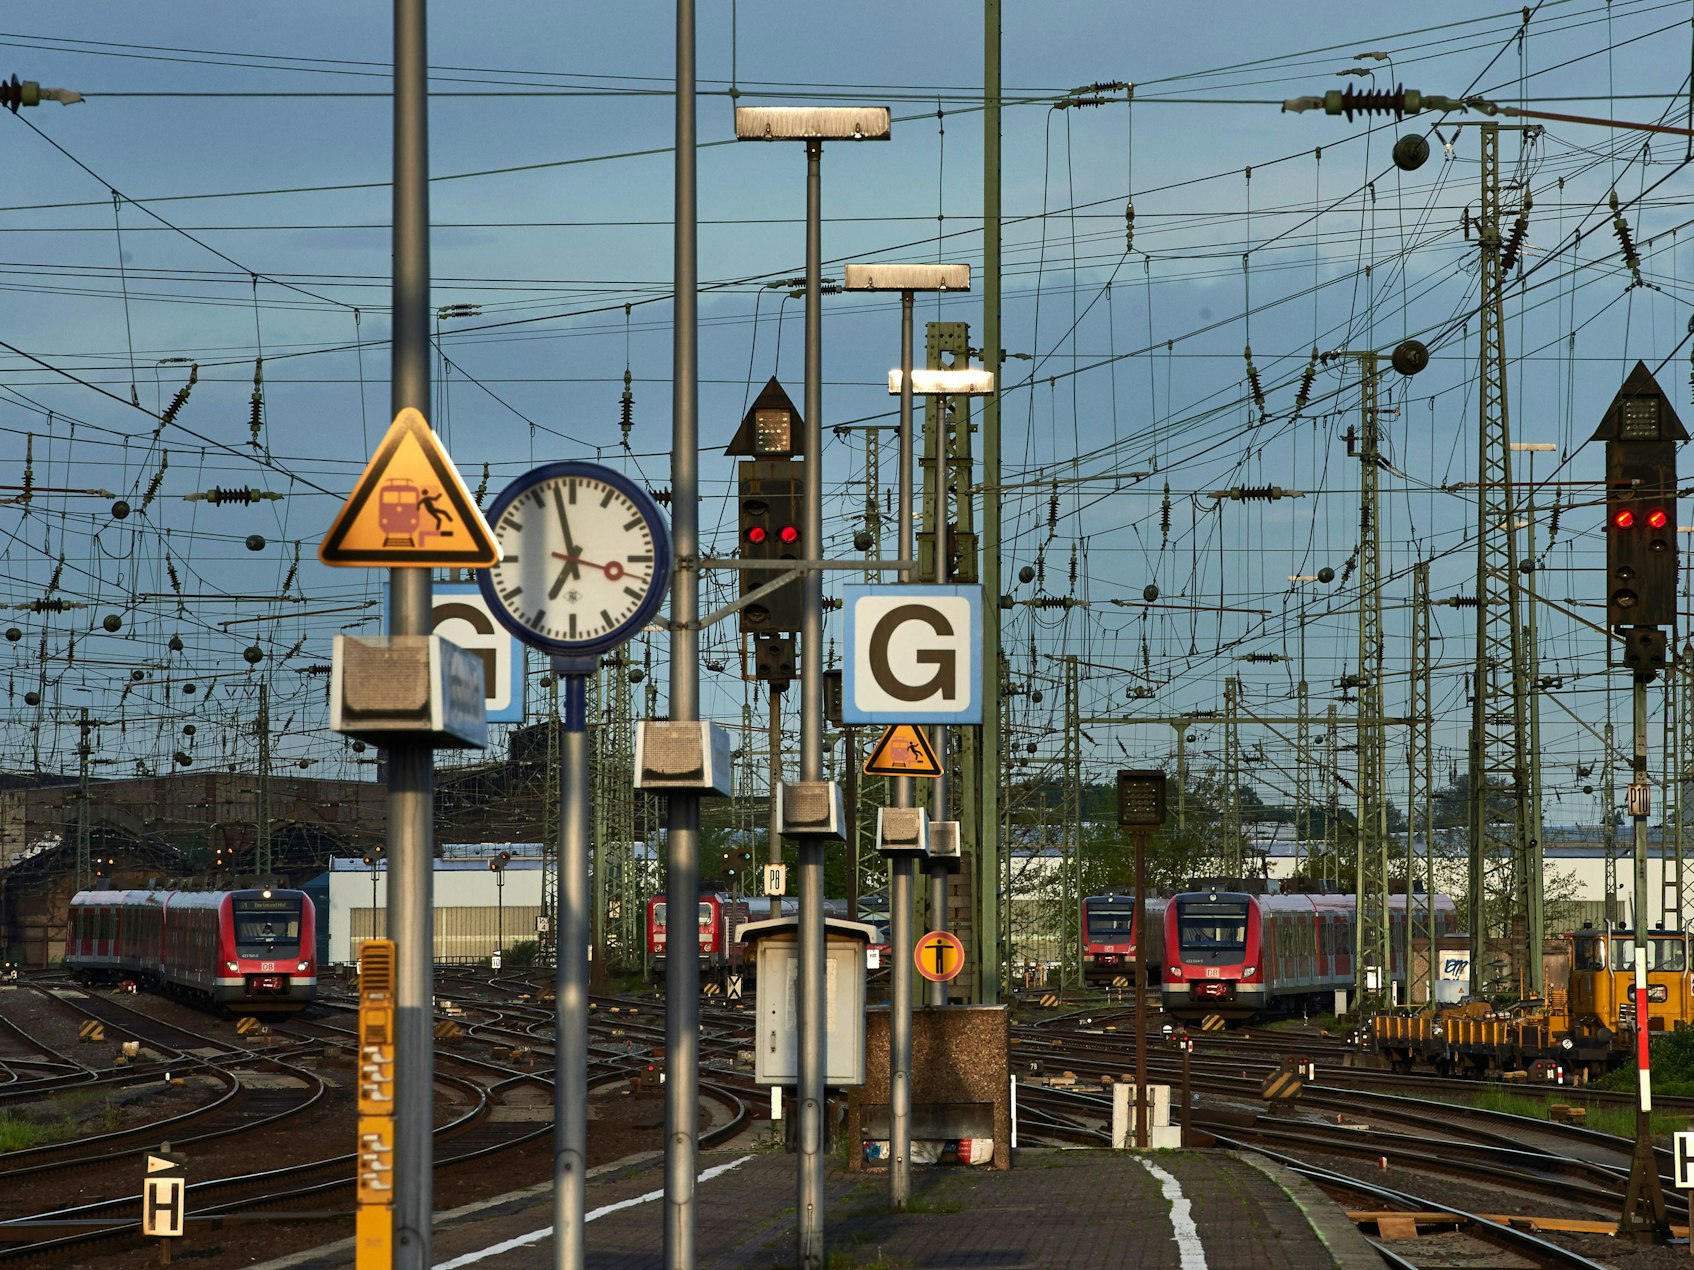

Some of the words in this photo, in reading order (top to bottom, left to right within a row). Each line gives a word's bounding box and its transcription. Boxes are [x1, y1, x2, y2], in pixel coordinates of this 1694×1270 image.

[869, 604, 956, 702] G
[1630, 787, 1648, 813] P10
[770, 869, 780, 890] P8
[262, 962, 274, 971] DB
[492, 958, 500, 967] 10
[1207, 969, 1218, 977] DB
[148, 1183, 179, 1231] H
